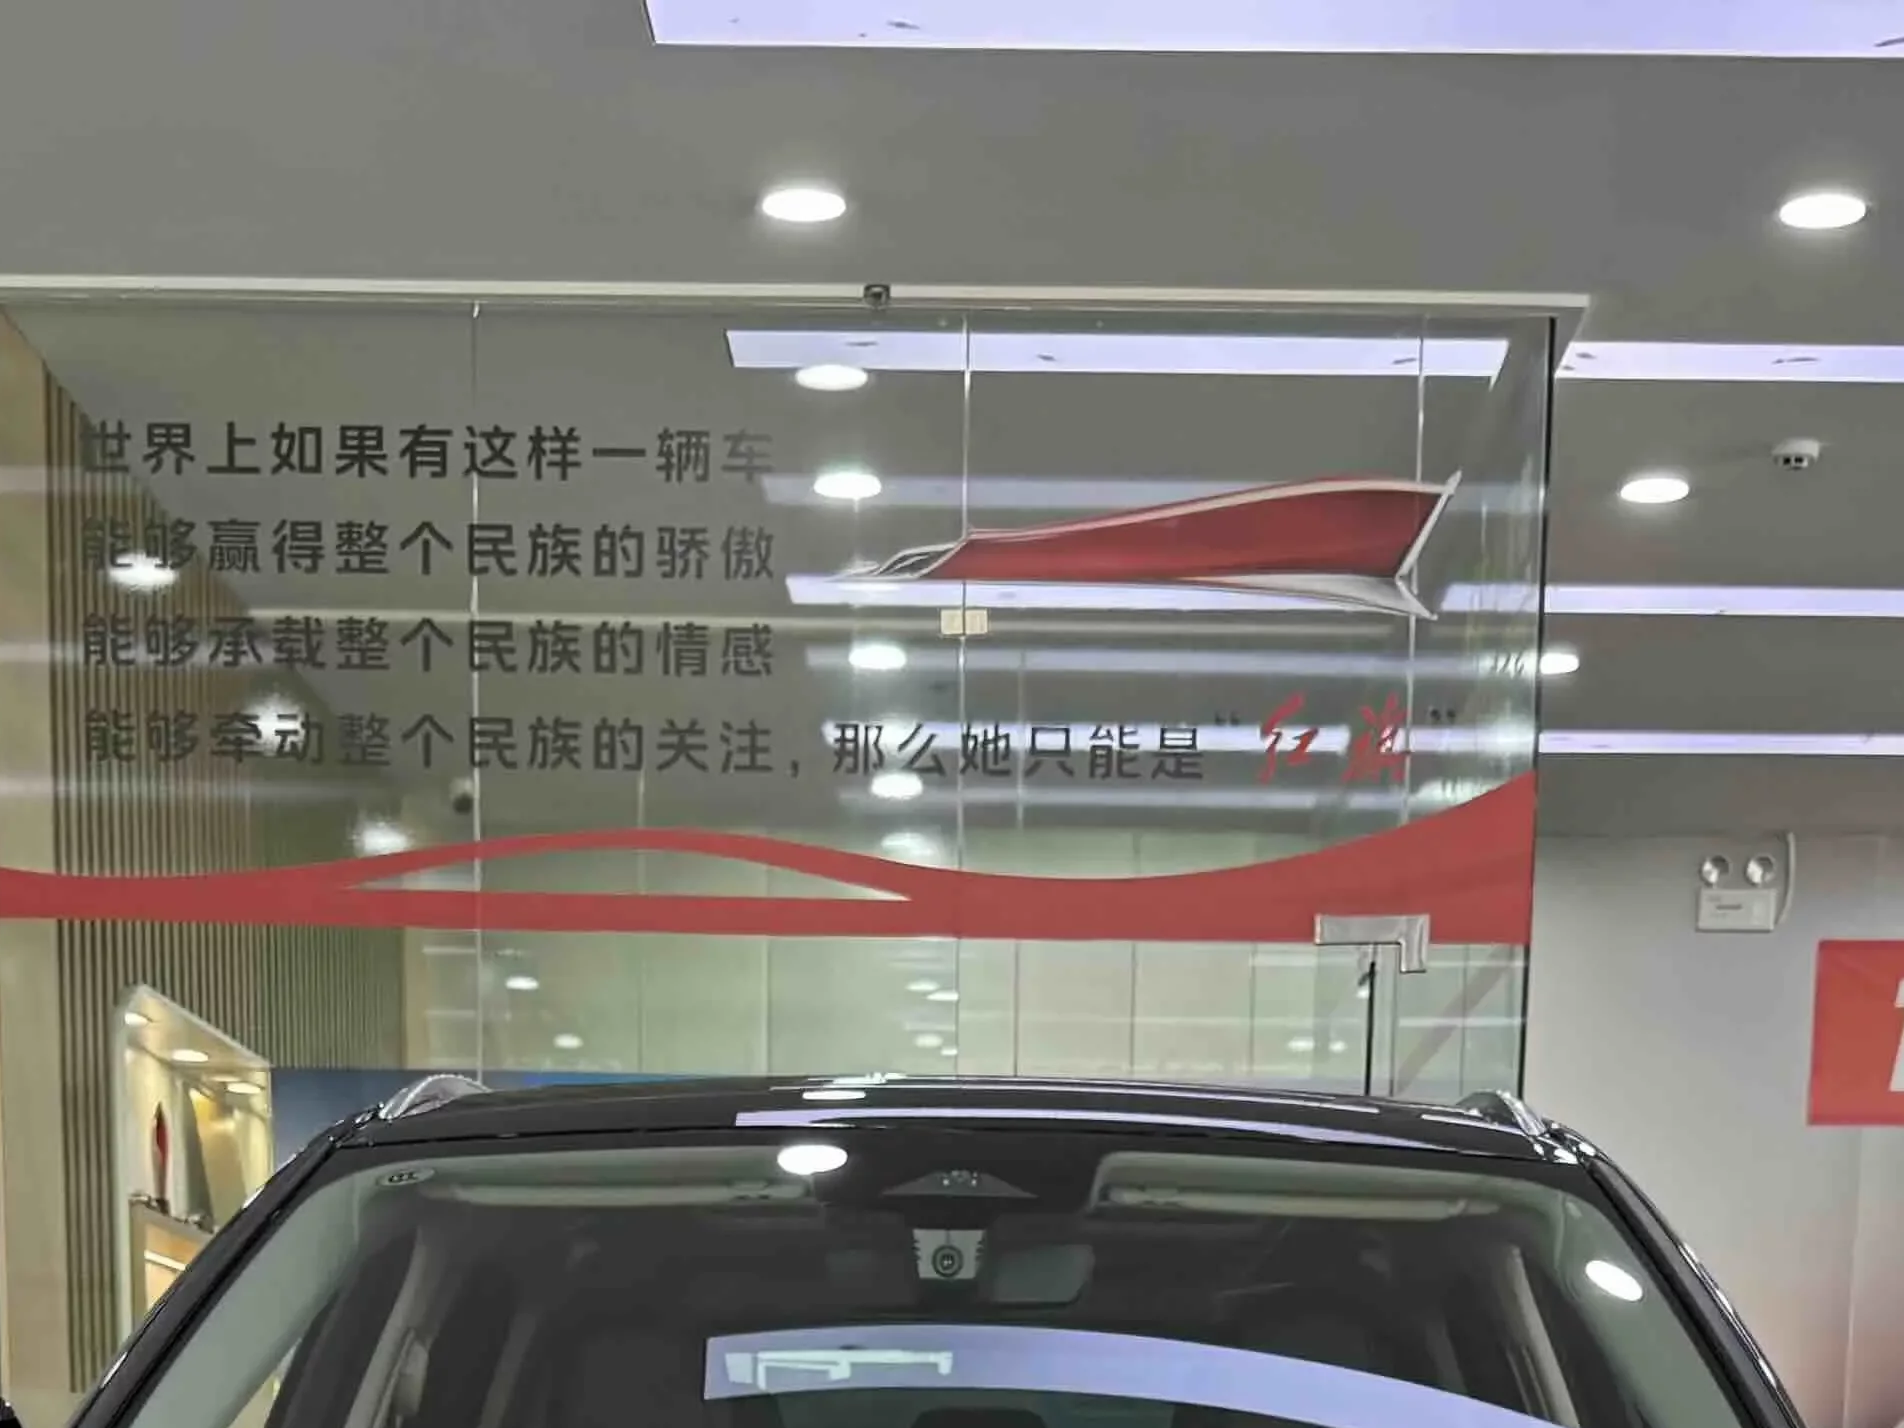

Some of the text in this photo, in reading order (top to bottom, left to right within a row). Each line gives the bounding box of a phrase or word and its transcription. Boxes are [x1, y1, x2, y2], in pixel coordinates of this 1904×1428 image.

[80, 419, 775, 484] 世界上如果有这样一辆车
[81, 516, 776, 582] 能够赢得整个民族的骄傲
[83, 614, 775, 679] 能够承载整个民族的情感
